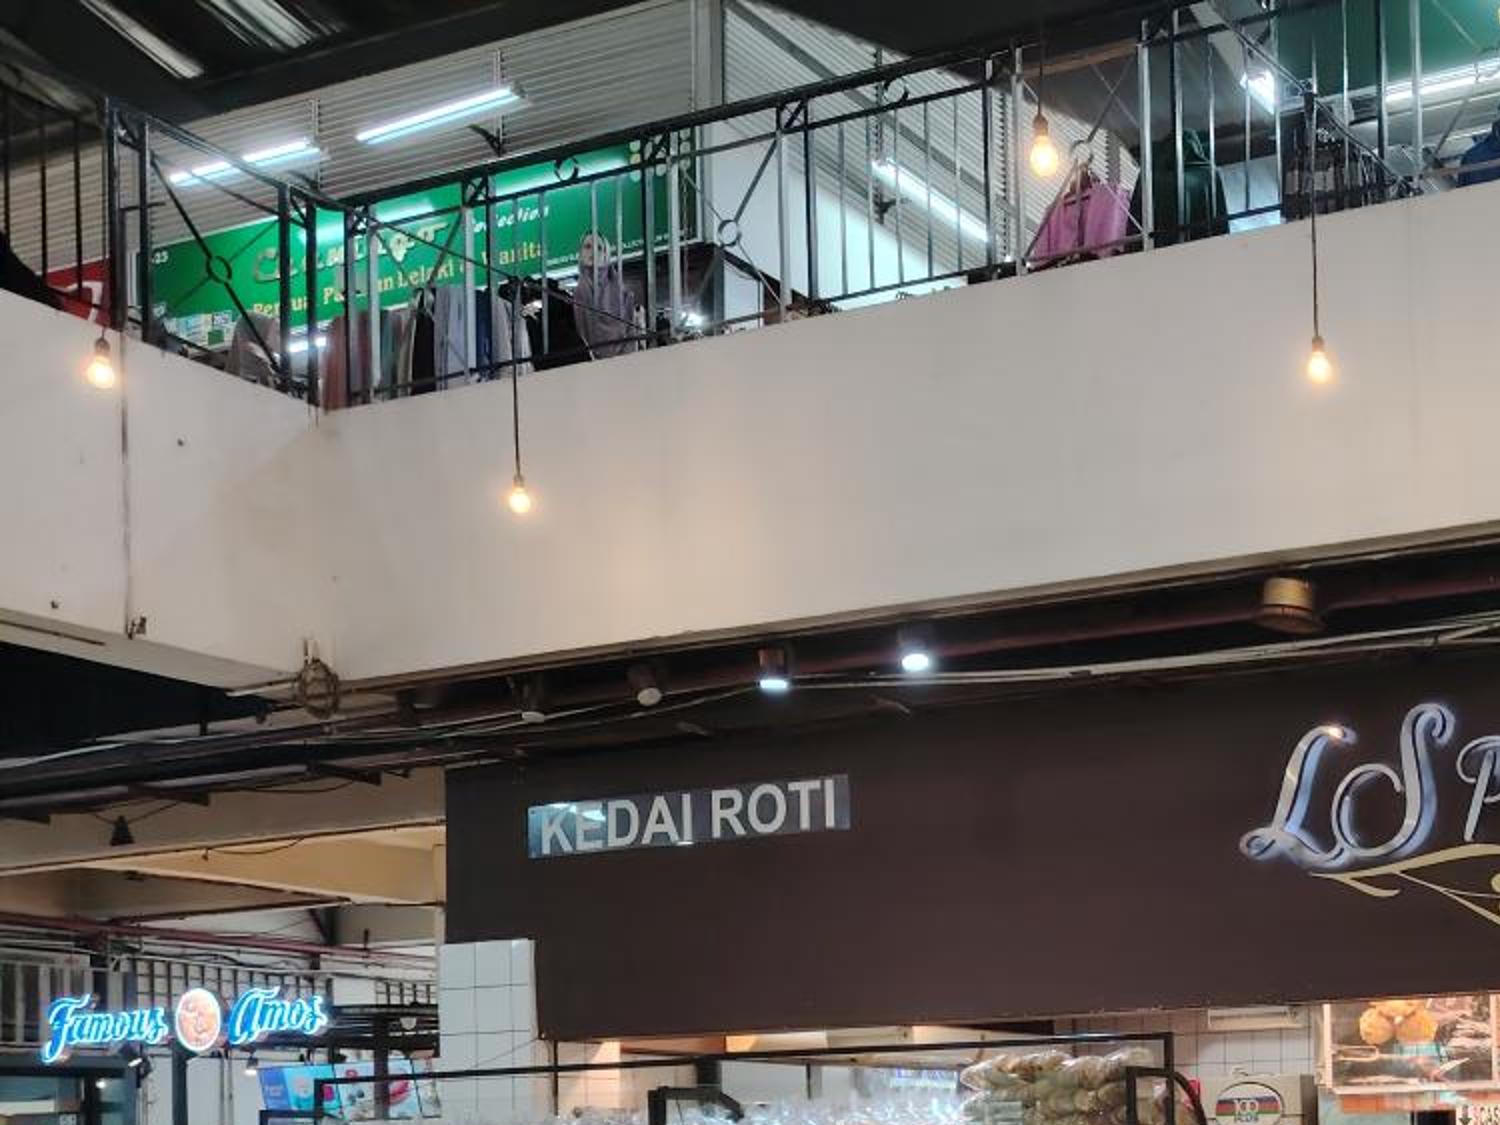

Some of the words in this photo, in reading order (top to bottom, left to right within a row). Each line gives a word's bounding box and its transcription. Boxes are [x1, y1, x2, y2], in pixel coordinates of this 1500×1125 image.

[541, 793, 693, 855] KEDAI
[712, 778, 835, 838] ROTI
[40, 993, 170, 1064] Famous
[228, 986, 329, 1045] Amos
